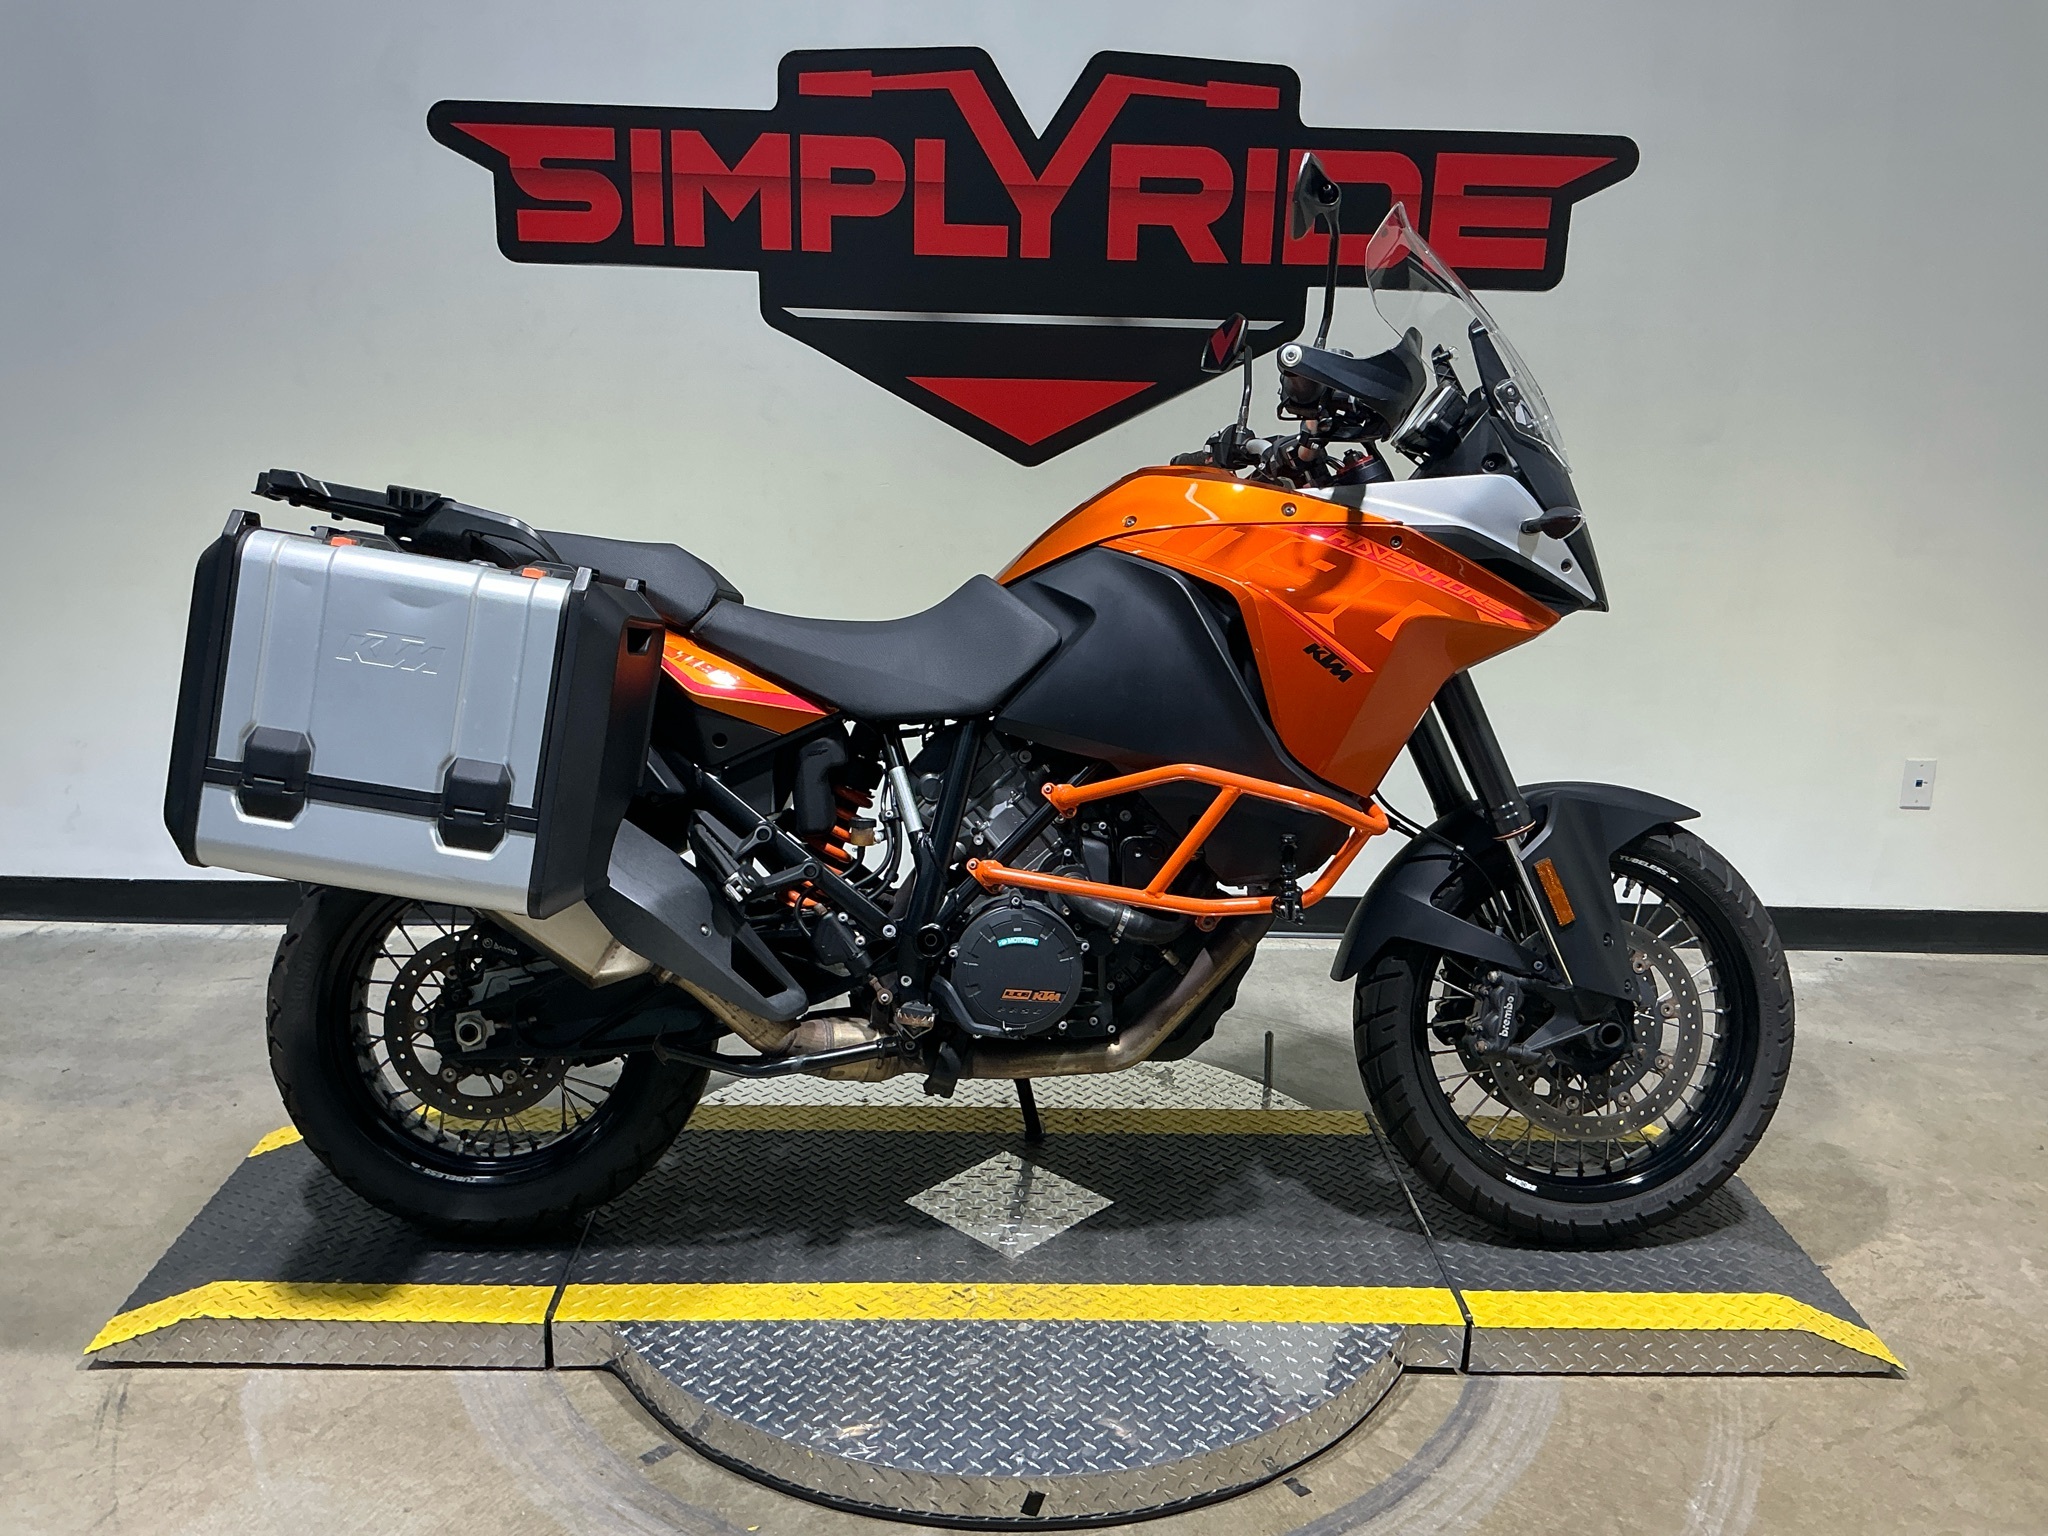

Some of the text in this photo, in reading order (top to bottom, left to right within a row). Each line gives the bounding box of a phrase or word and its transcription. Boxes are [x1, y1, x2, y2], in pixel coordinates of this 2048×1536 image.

[1325, 528, 1506, 617] ADVENTURE
[335, 629, 446, 675] KTM
[1302, 643, 1354, 683] KTM
[1619, 854, 1669, 877] TUBELESS
[1031, 990, 1061, 1002] KTM
[1499, 995, 1515, 1037] brembo
